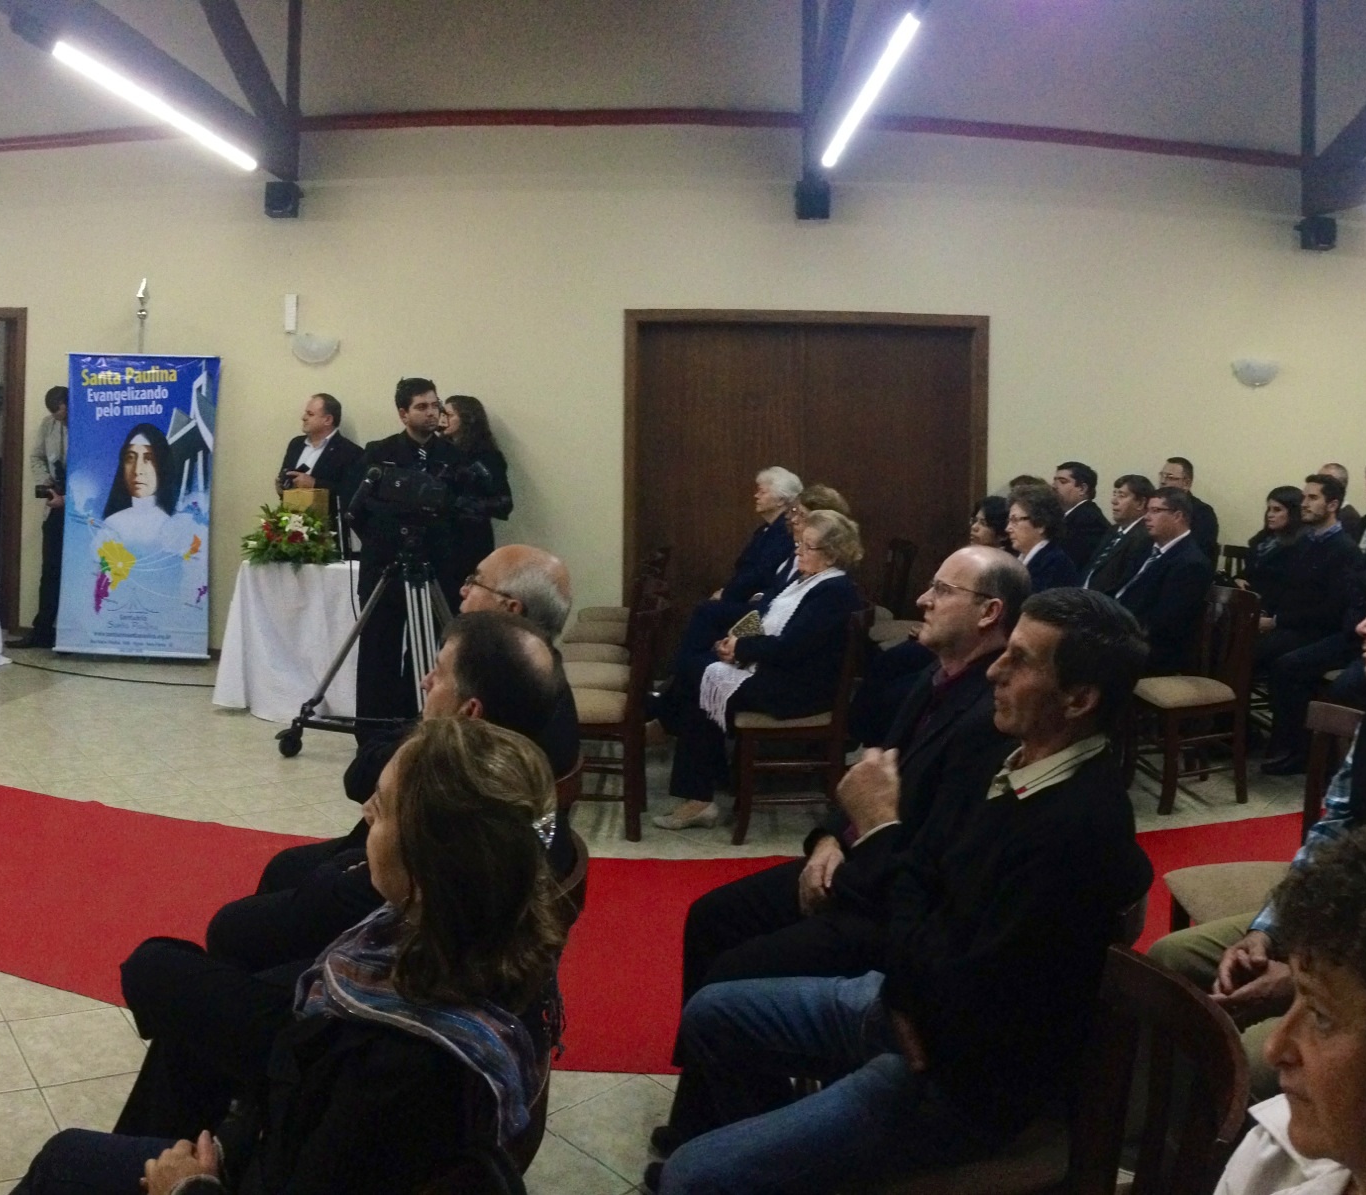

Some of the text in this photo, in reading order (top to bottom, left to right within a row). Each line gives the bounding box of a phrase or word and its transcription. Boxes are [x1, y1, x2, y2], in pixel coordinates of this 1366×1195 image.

[81, 365, 177, 386] Santa Paulina
[87, 385, 169, 404] Evangelizando
[95, 401, 163, 420] pelo mundo
